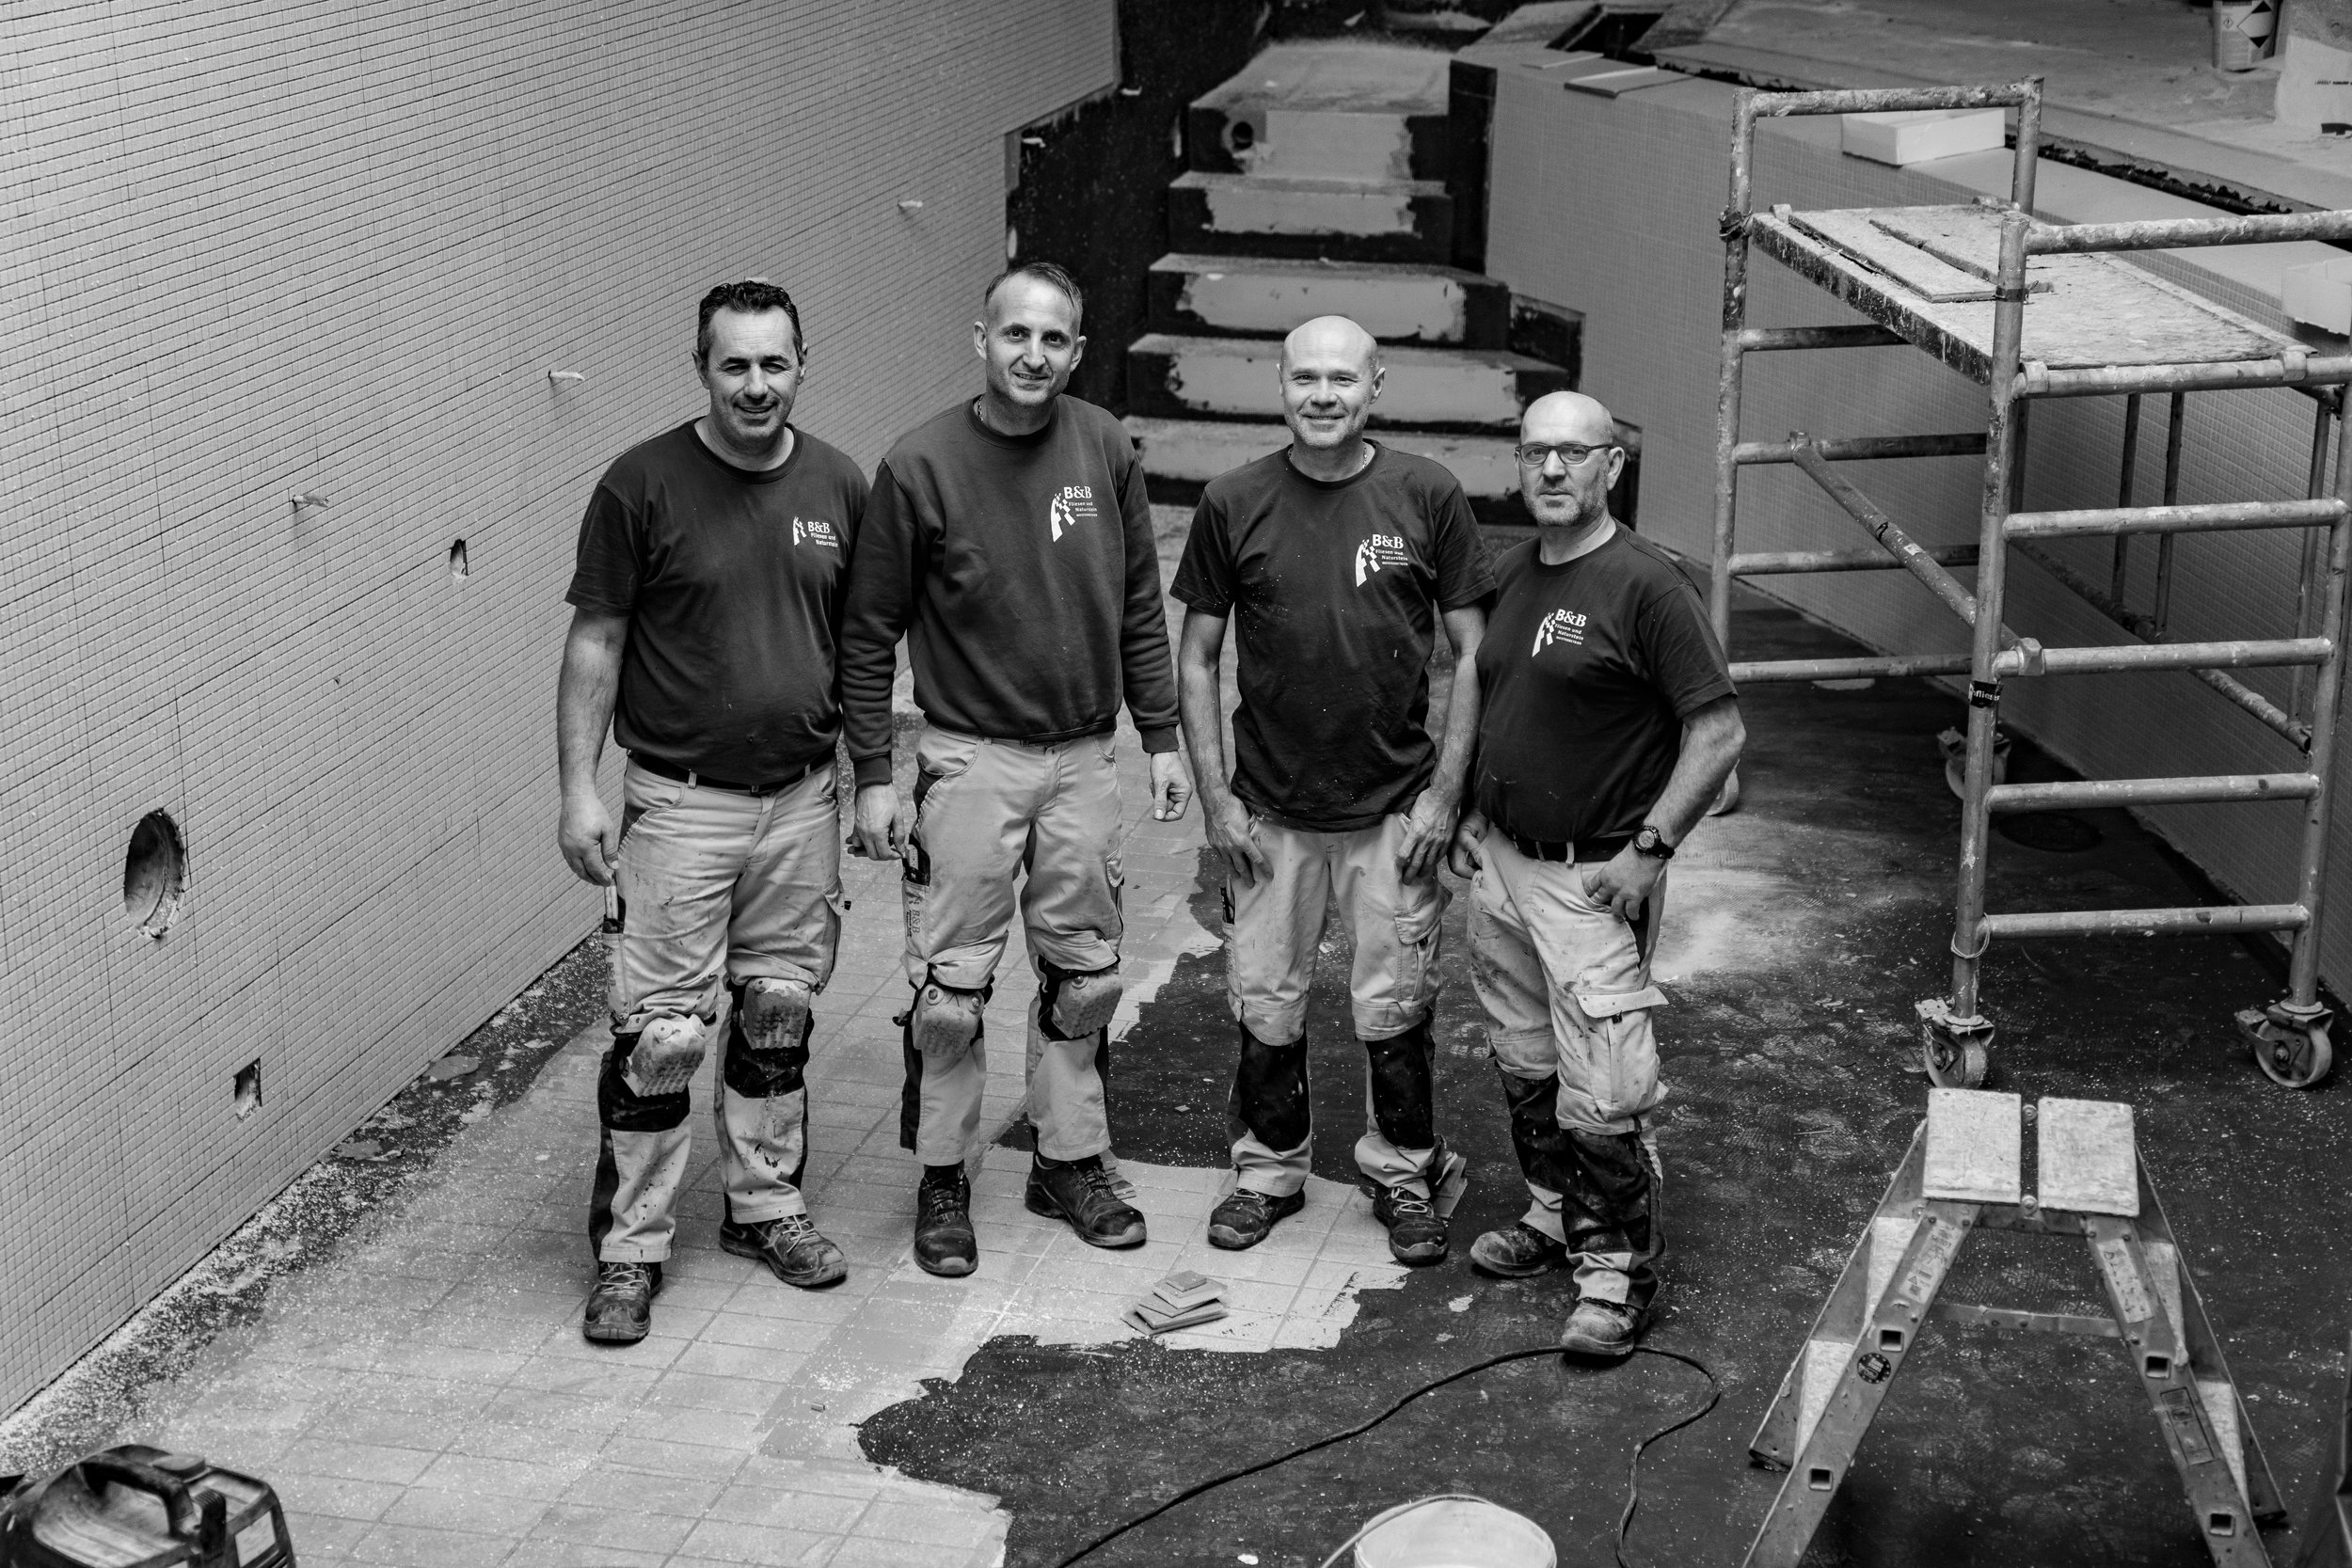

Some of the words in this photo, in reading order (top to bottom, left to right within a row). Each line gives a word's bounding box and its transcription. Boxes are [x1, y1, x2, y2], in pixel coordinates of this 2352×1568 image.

[1064, 485, 1092, 499] B&B
[807, 521, 831, 533] B&B
[1372, 533, 1405, 549] B&B
[1554, 609, 1587, 627] B&B
[912, 909, 921, 934] B&B
